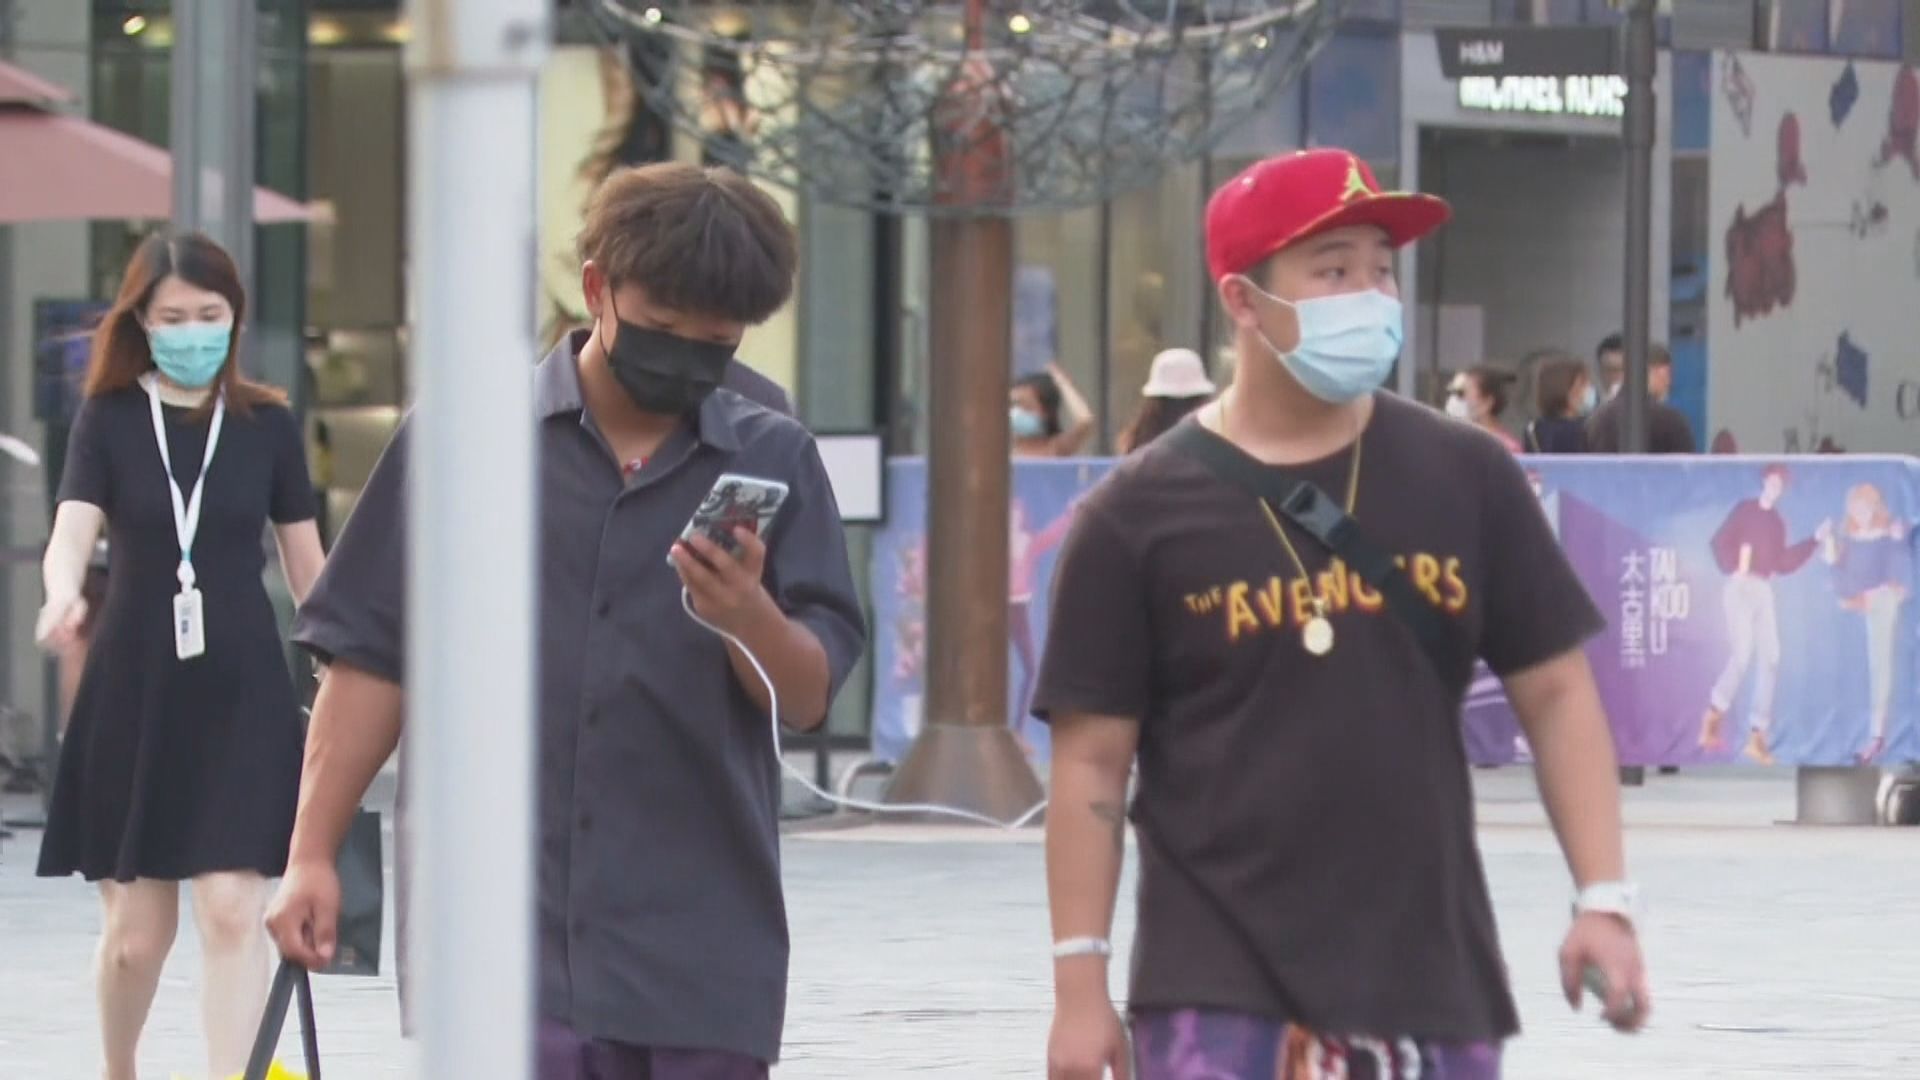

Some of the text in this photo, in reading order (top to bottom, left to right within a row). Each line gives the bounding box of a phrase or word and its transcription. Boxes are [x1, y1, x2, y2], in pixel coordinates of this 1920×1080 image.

[1459, 41, 1504, 65] H&M
[1184, 584, 1221, 614] THE
[1619, 549, 1646, 656] 太古里
